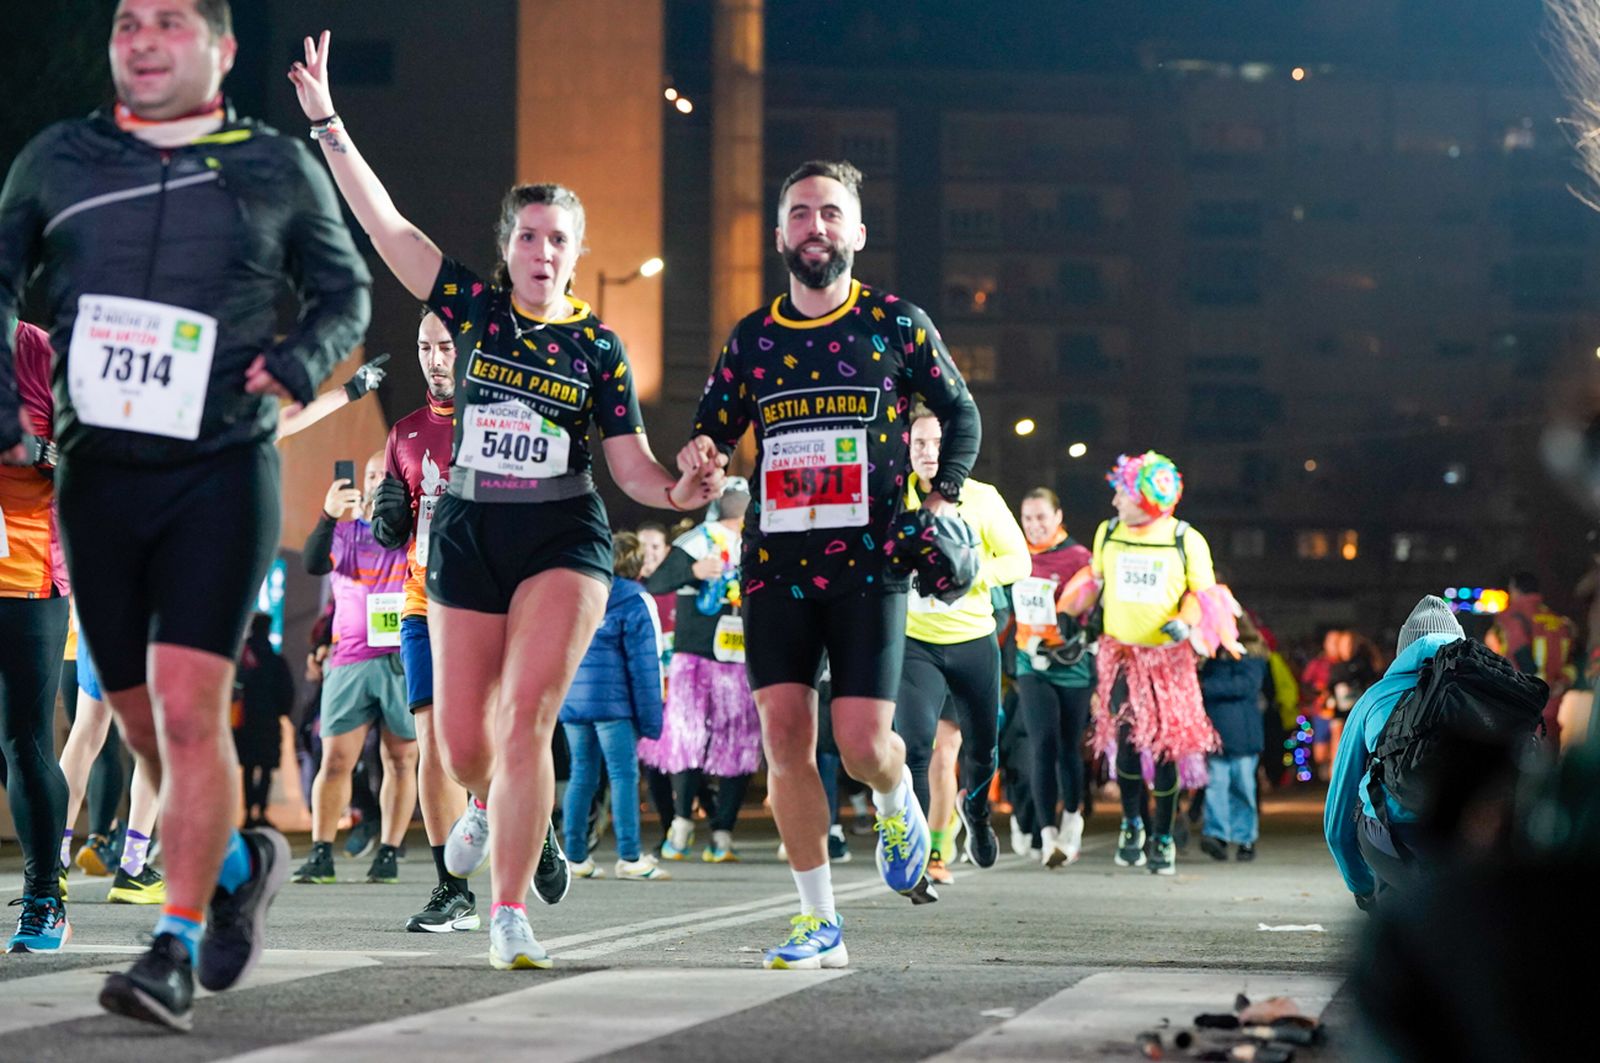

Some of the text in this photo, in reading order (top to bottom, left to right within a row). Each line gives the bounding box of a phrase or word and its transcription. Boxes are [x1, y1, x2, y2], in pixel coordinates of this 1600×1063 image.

[101, 346, 172, 387] 7314
[473, 359, 578, 403] BESTIA PARDA
[489, 407, 518, 418] NOCHE
[764, 396, 867, 423] BESTIA PARDA
[476, 417, 496, 429] SAN
[482, 431, 548, 463] 5409
[782, 443, 825, 455] NOCHE DE
[773, 459, 789, 470] SAN
[784, 468, 842, 497] 5871
[1124, 571, 1156, 586] 3549
